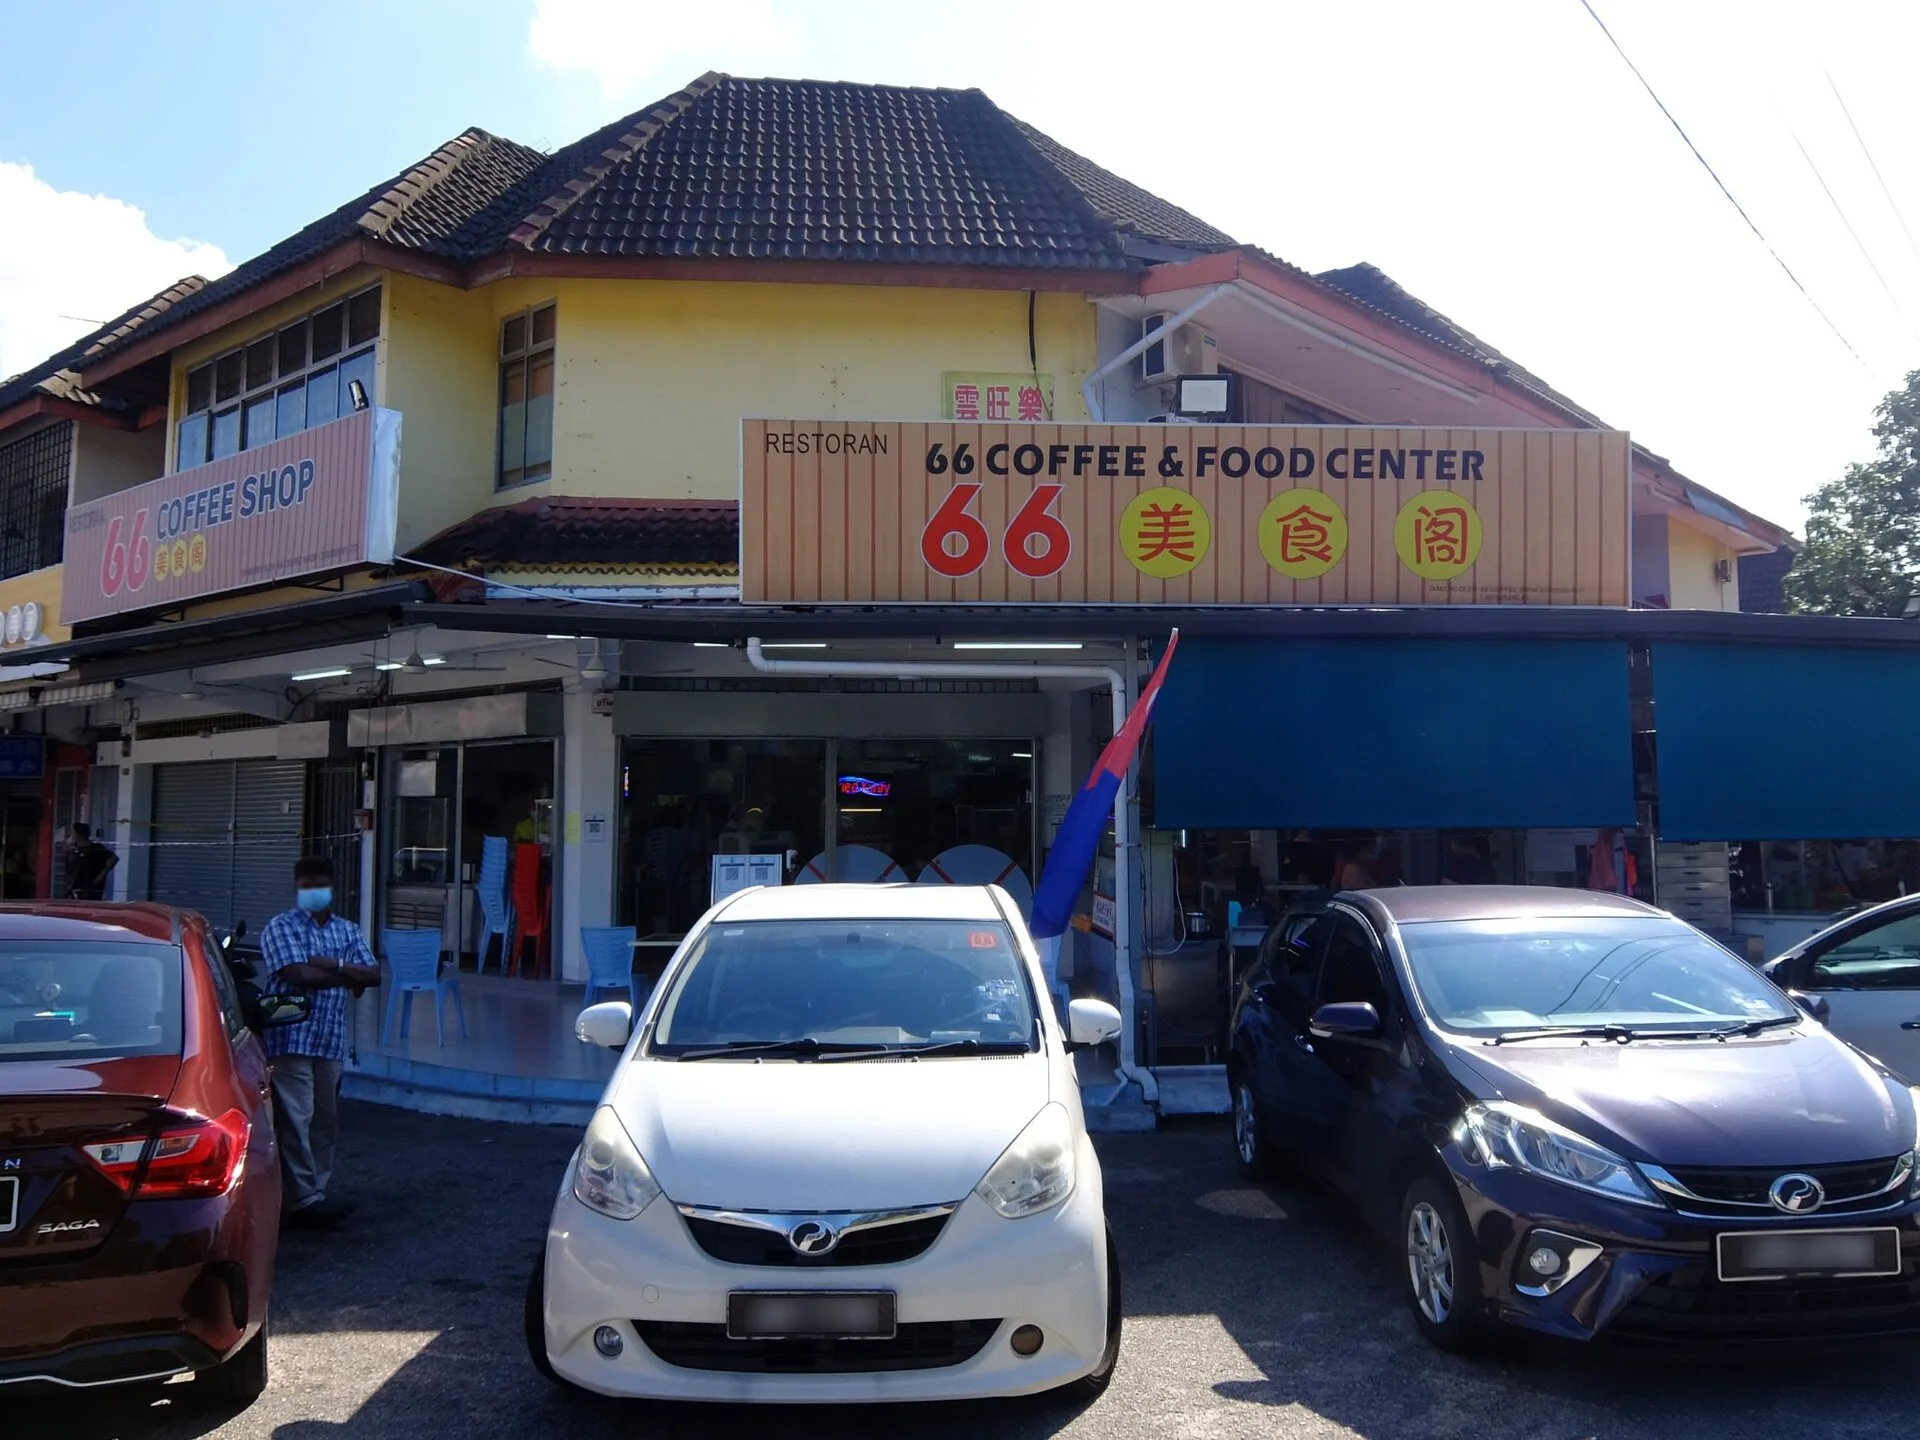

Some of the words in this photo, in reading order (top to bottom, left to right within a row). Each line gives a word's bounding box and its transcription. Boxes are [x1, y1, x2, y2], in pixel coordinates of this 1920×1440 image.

[955, 385, 1053, 420] 雲旺樂
[766, 433, 888, 454] RESTORAN
[926, 443, 975, 475] 66
[986, 443, 1147, 477] COFFEE
[1158, 446, 1184, 478] &
[1196, 446, 1316, 478] FOOD
[1326, 448, 1485, 481] CENTER
[156, 481, 237, 541] COFFEE
[239, 458, 315, 518] SHOP
[921, 482, 1071, 578] 66
[101, 508, 151, 598] 66
[37, 1219, 100, 1234] SAGA
